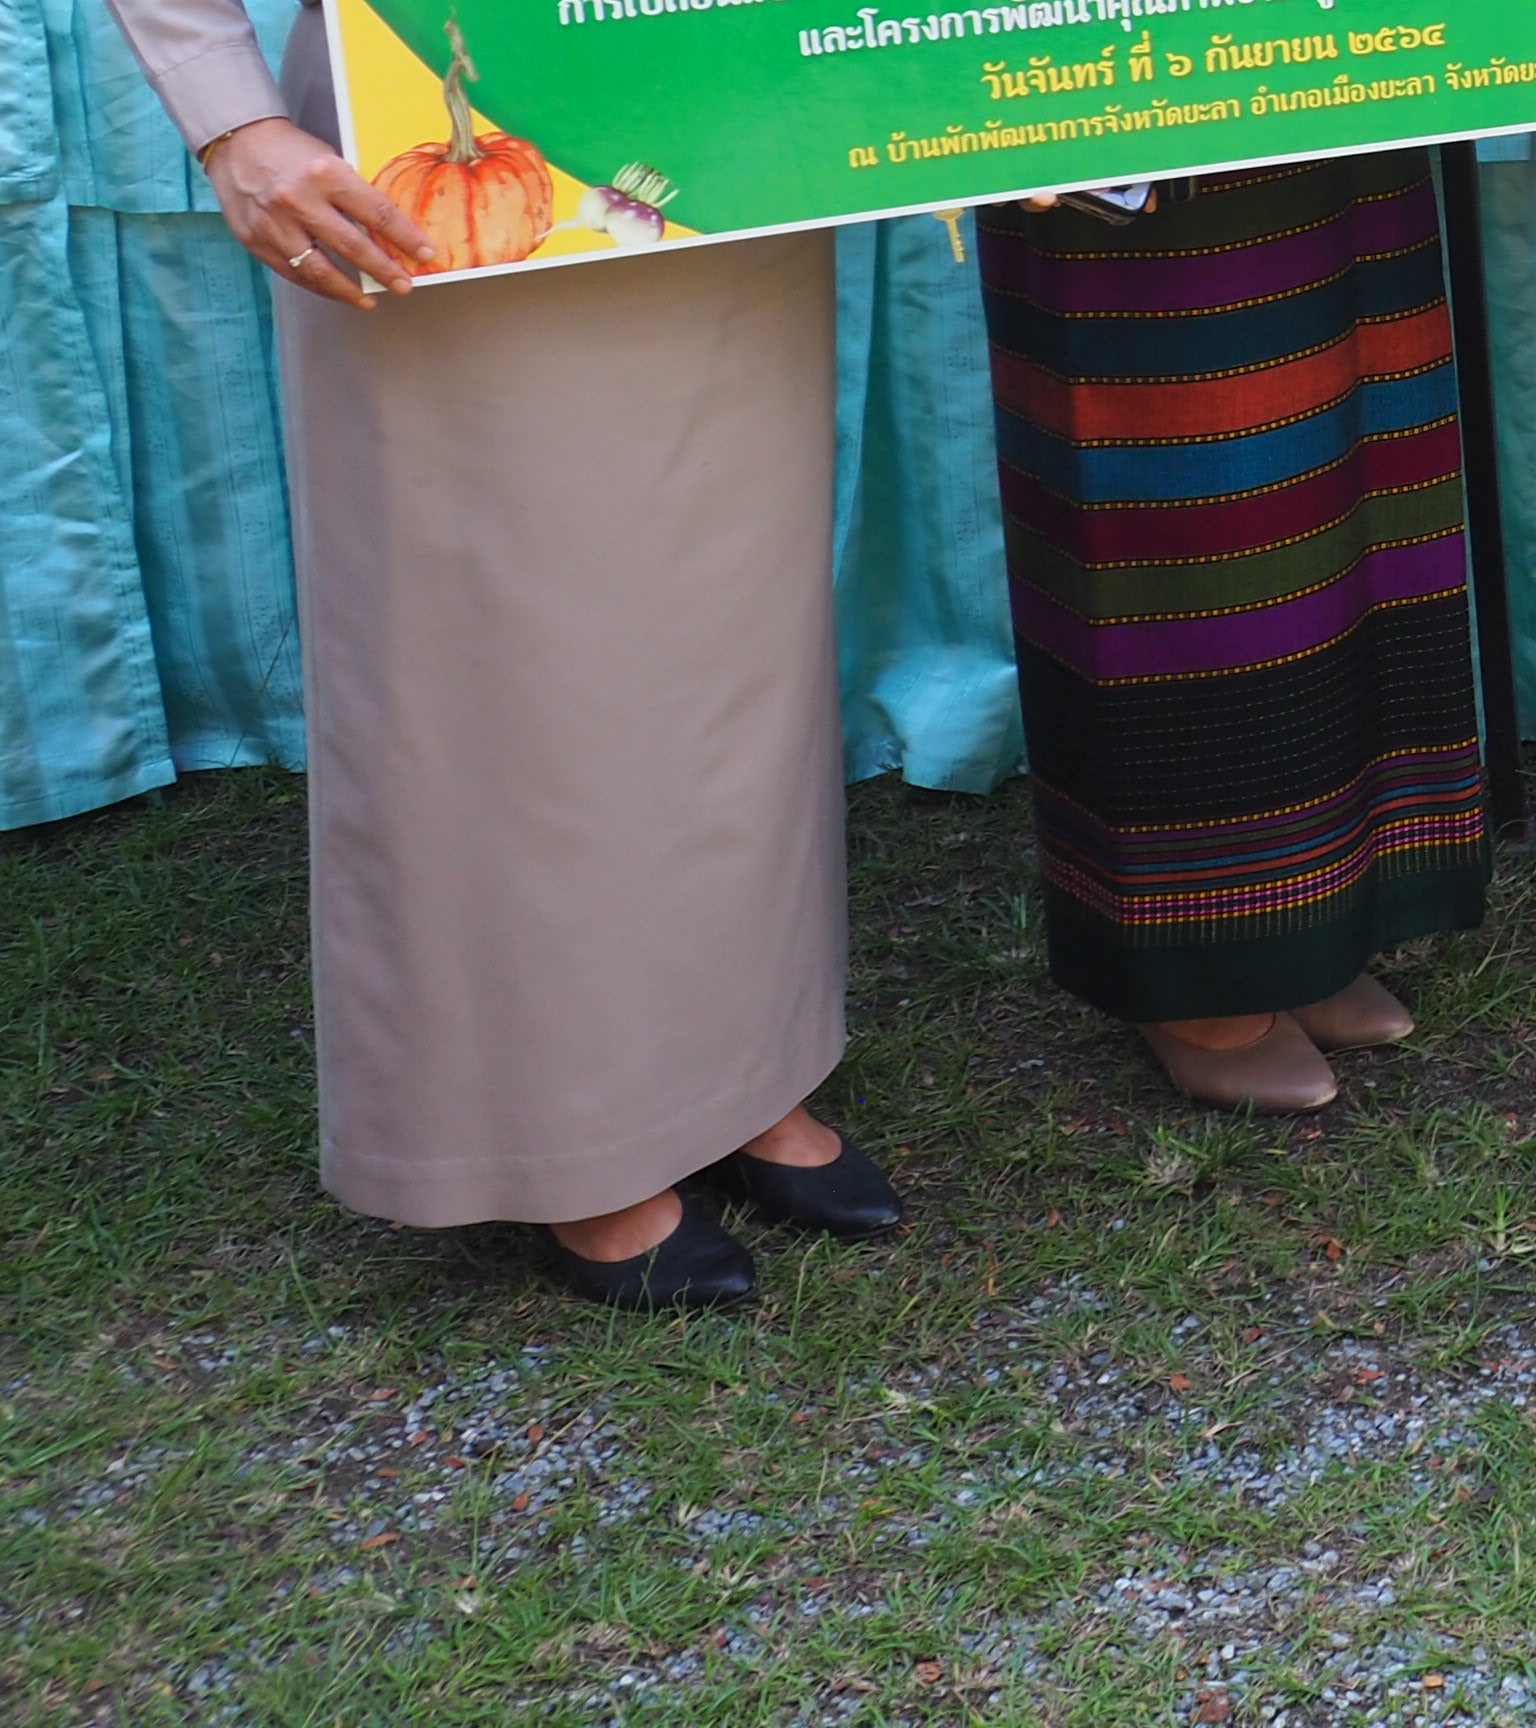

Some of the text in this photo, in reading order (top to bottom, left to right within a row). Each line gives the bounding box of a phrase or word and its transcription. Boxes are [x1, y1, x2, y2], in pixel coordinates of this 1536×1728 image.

[981, 22, 1446, 101] วันจันทร์ ที่ ๖ กันยายน ๒๕๖๔
[848, 145, 879, 169] ณ
[886, 97, 1242, 164] บ้านพักพัฒนาการจังหวัดยะลา
[1250, 73, 1436, 116] อำเภอเมืองยะลา
